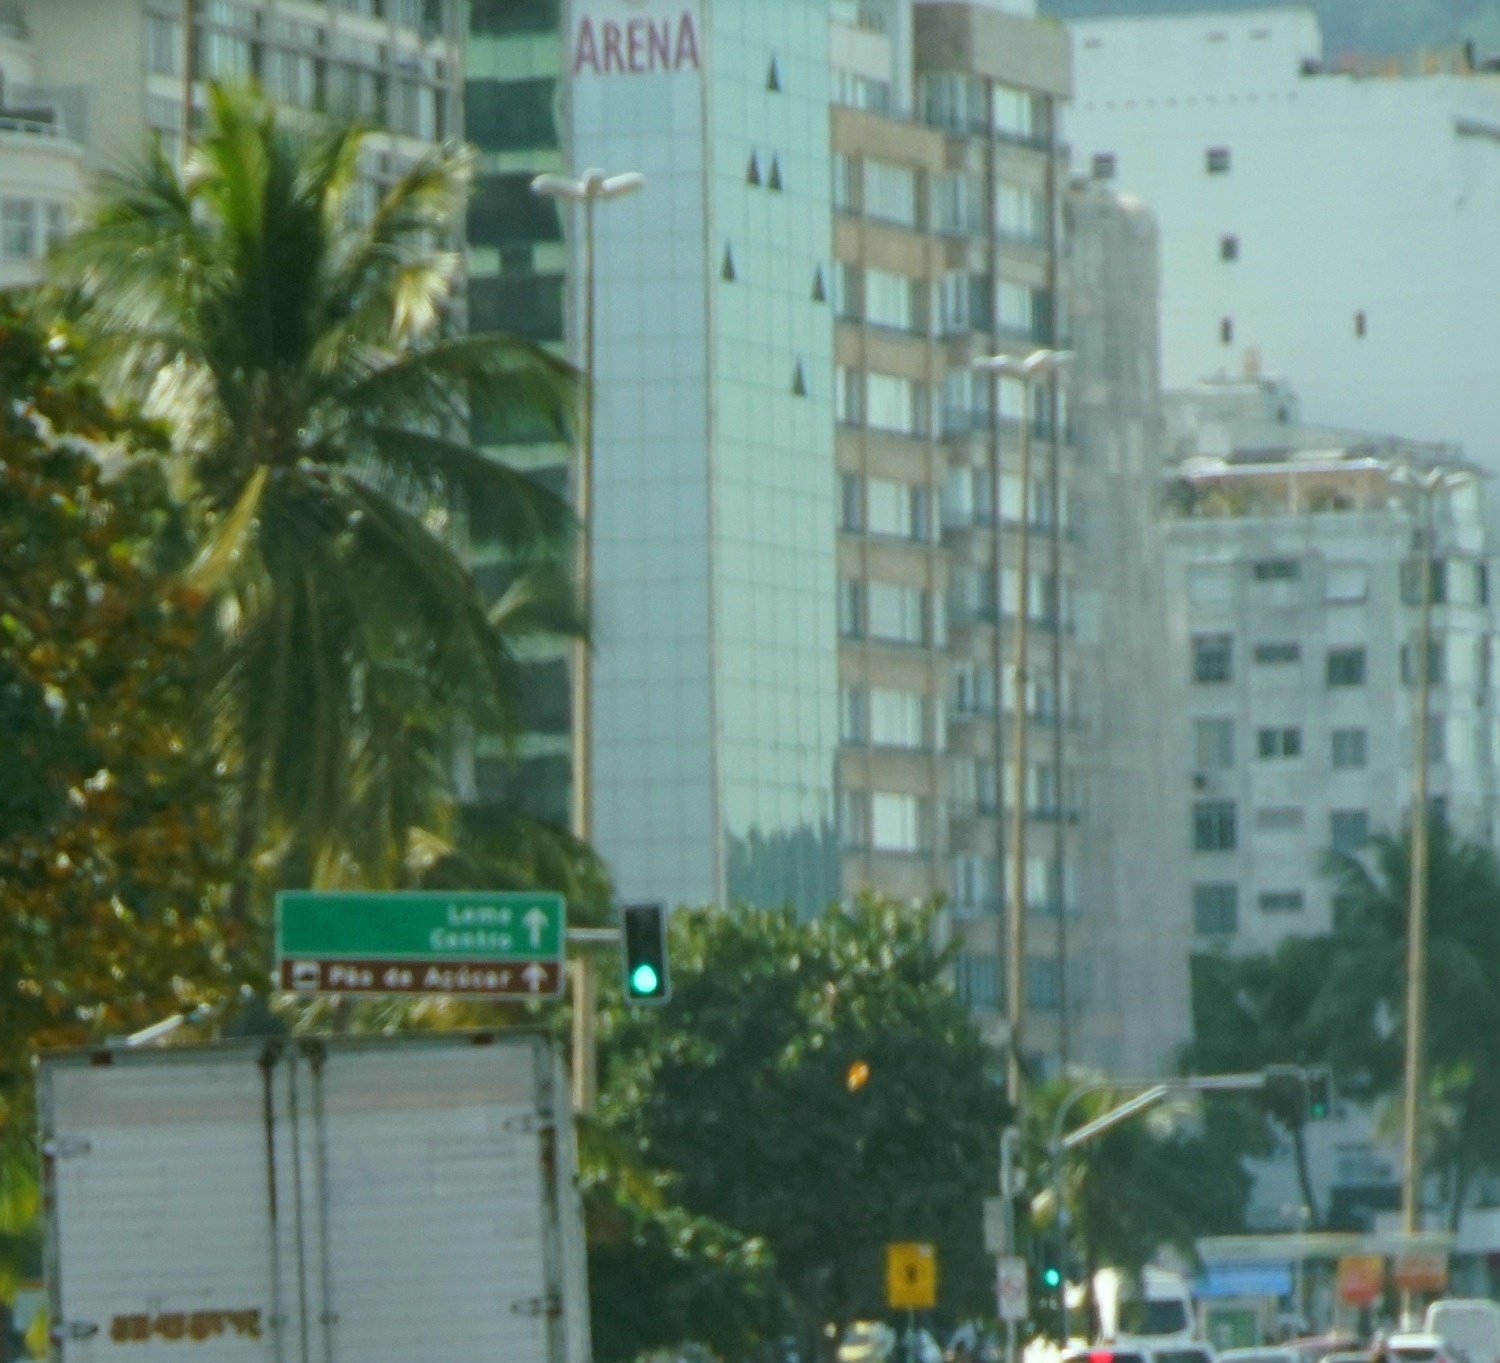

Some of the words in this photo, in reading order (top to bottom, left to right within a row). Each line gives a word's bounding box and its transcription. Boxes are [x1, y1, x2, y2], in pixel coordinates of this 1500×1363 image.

[573, 9, 703, 75] ARENA
[447, 904, 513, 927] Leme
[430, 928, 513, 951] Centro
[383, 964, 414, 988] de
[423, 962, 513, 992] Açúcar
